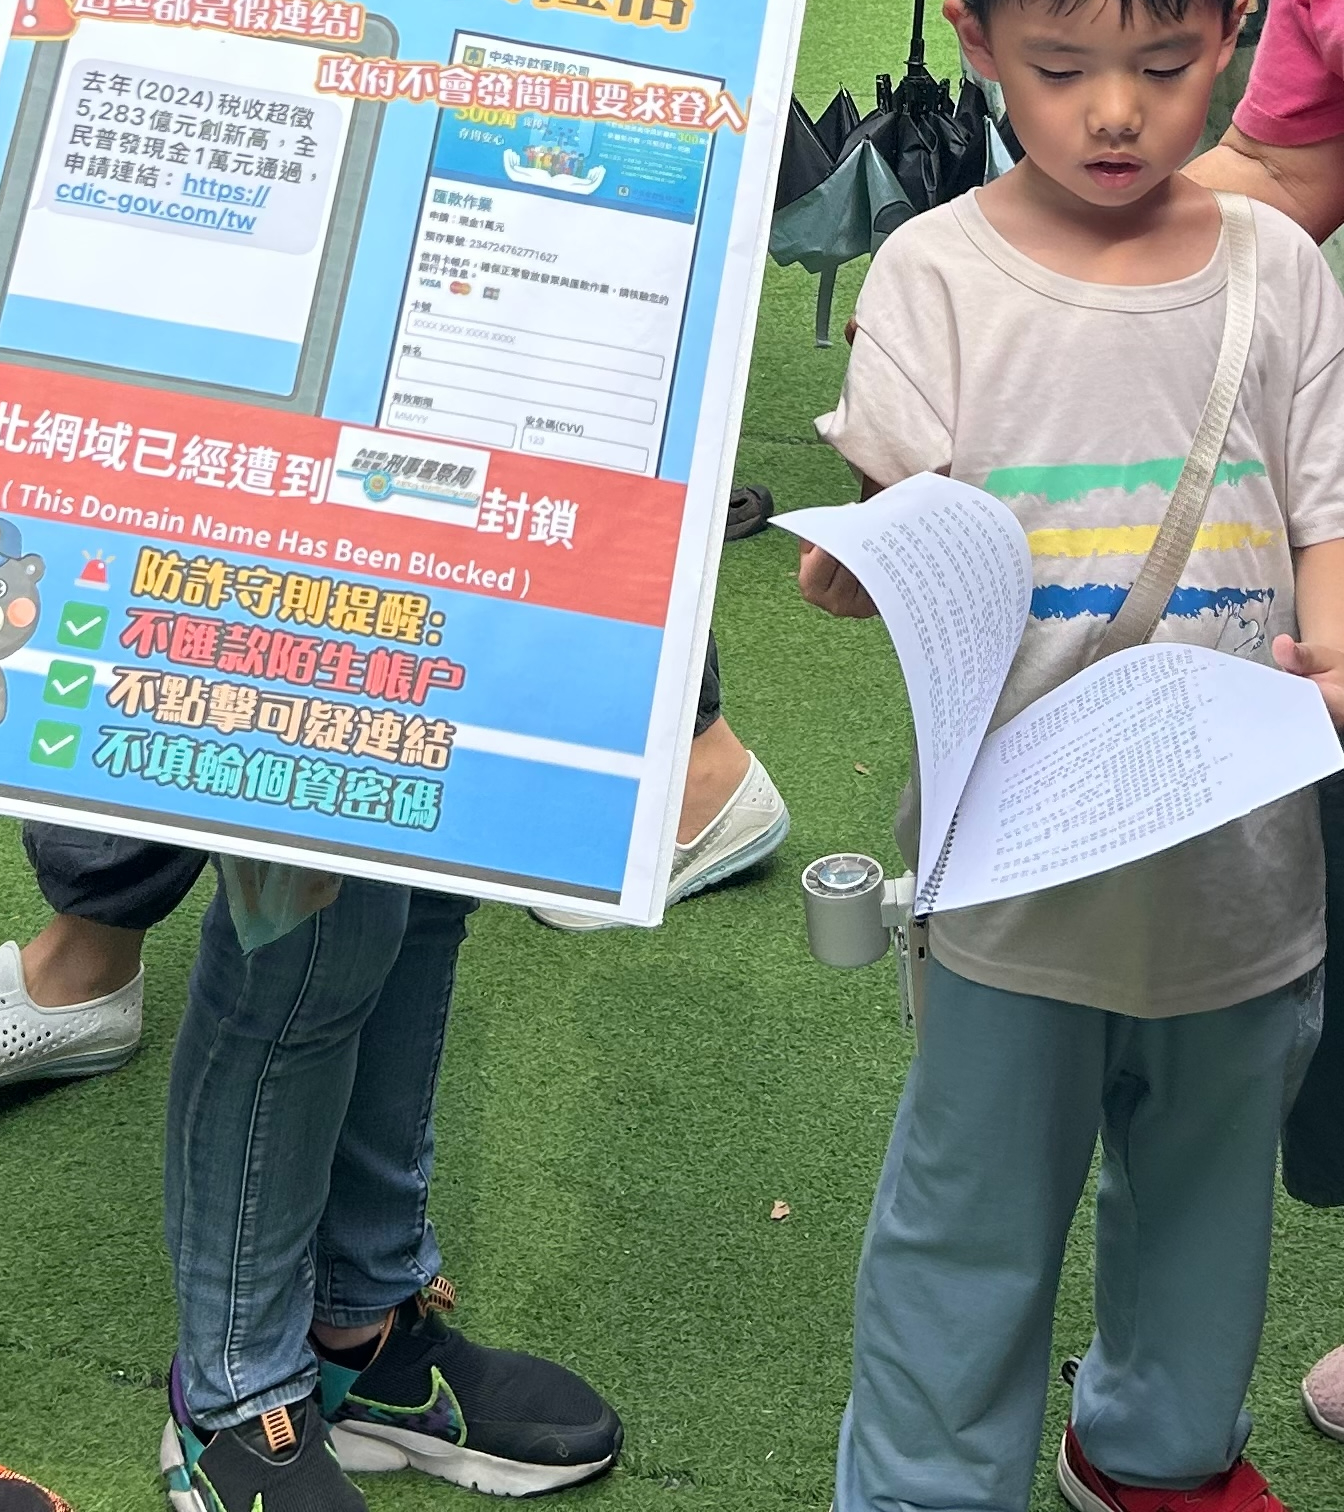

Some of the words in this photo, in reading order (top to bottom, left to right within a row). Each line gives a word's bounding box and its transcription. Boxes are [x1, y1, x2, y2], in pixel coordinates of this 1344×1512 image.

[319, 56, 746, 132] 政府不會發簡訊要求登入
[55, 181, 258, 234] cdic-gov.com/tw
[182, 172, 272, 207] https://
[419, 277, 442, 289] VISA
[19, 484, 74, 516] This
[80, 498, 184, 533] Domain
[191, 518, 271, 549] Name
[278, 530, 328, 560] Has
[336, 541, 401, 572] Been
[408, 550, 515, 594] Blocked
[477, 485, 577, 551] 封鎖
[132, 547, 446, 646] 防詐守則提醒:
[107, 666, 456, 771] 不點擊可疑連結
[93, 726, 444, 832] 不填輸個資密碼
